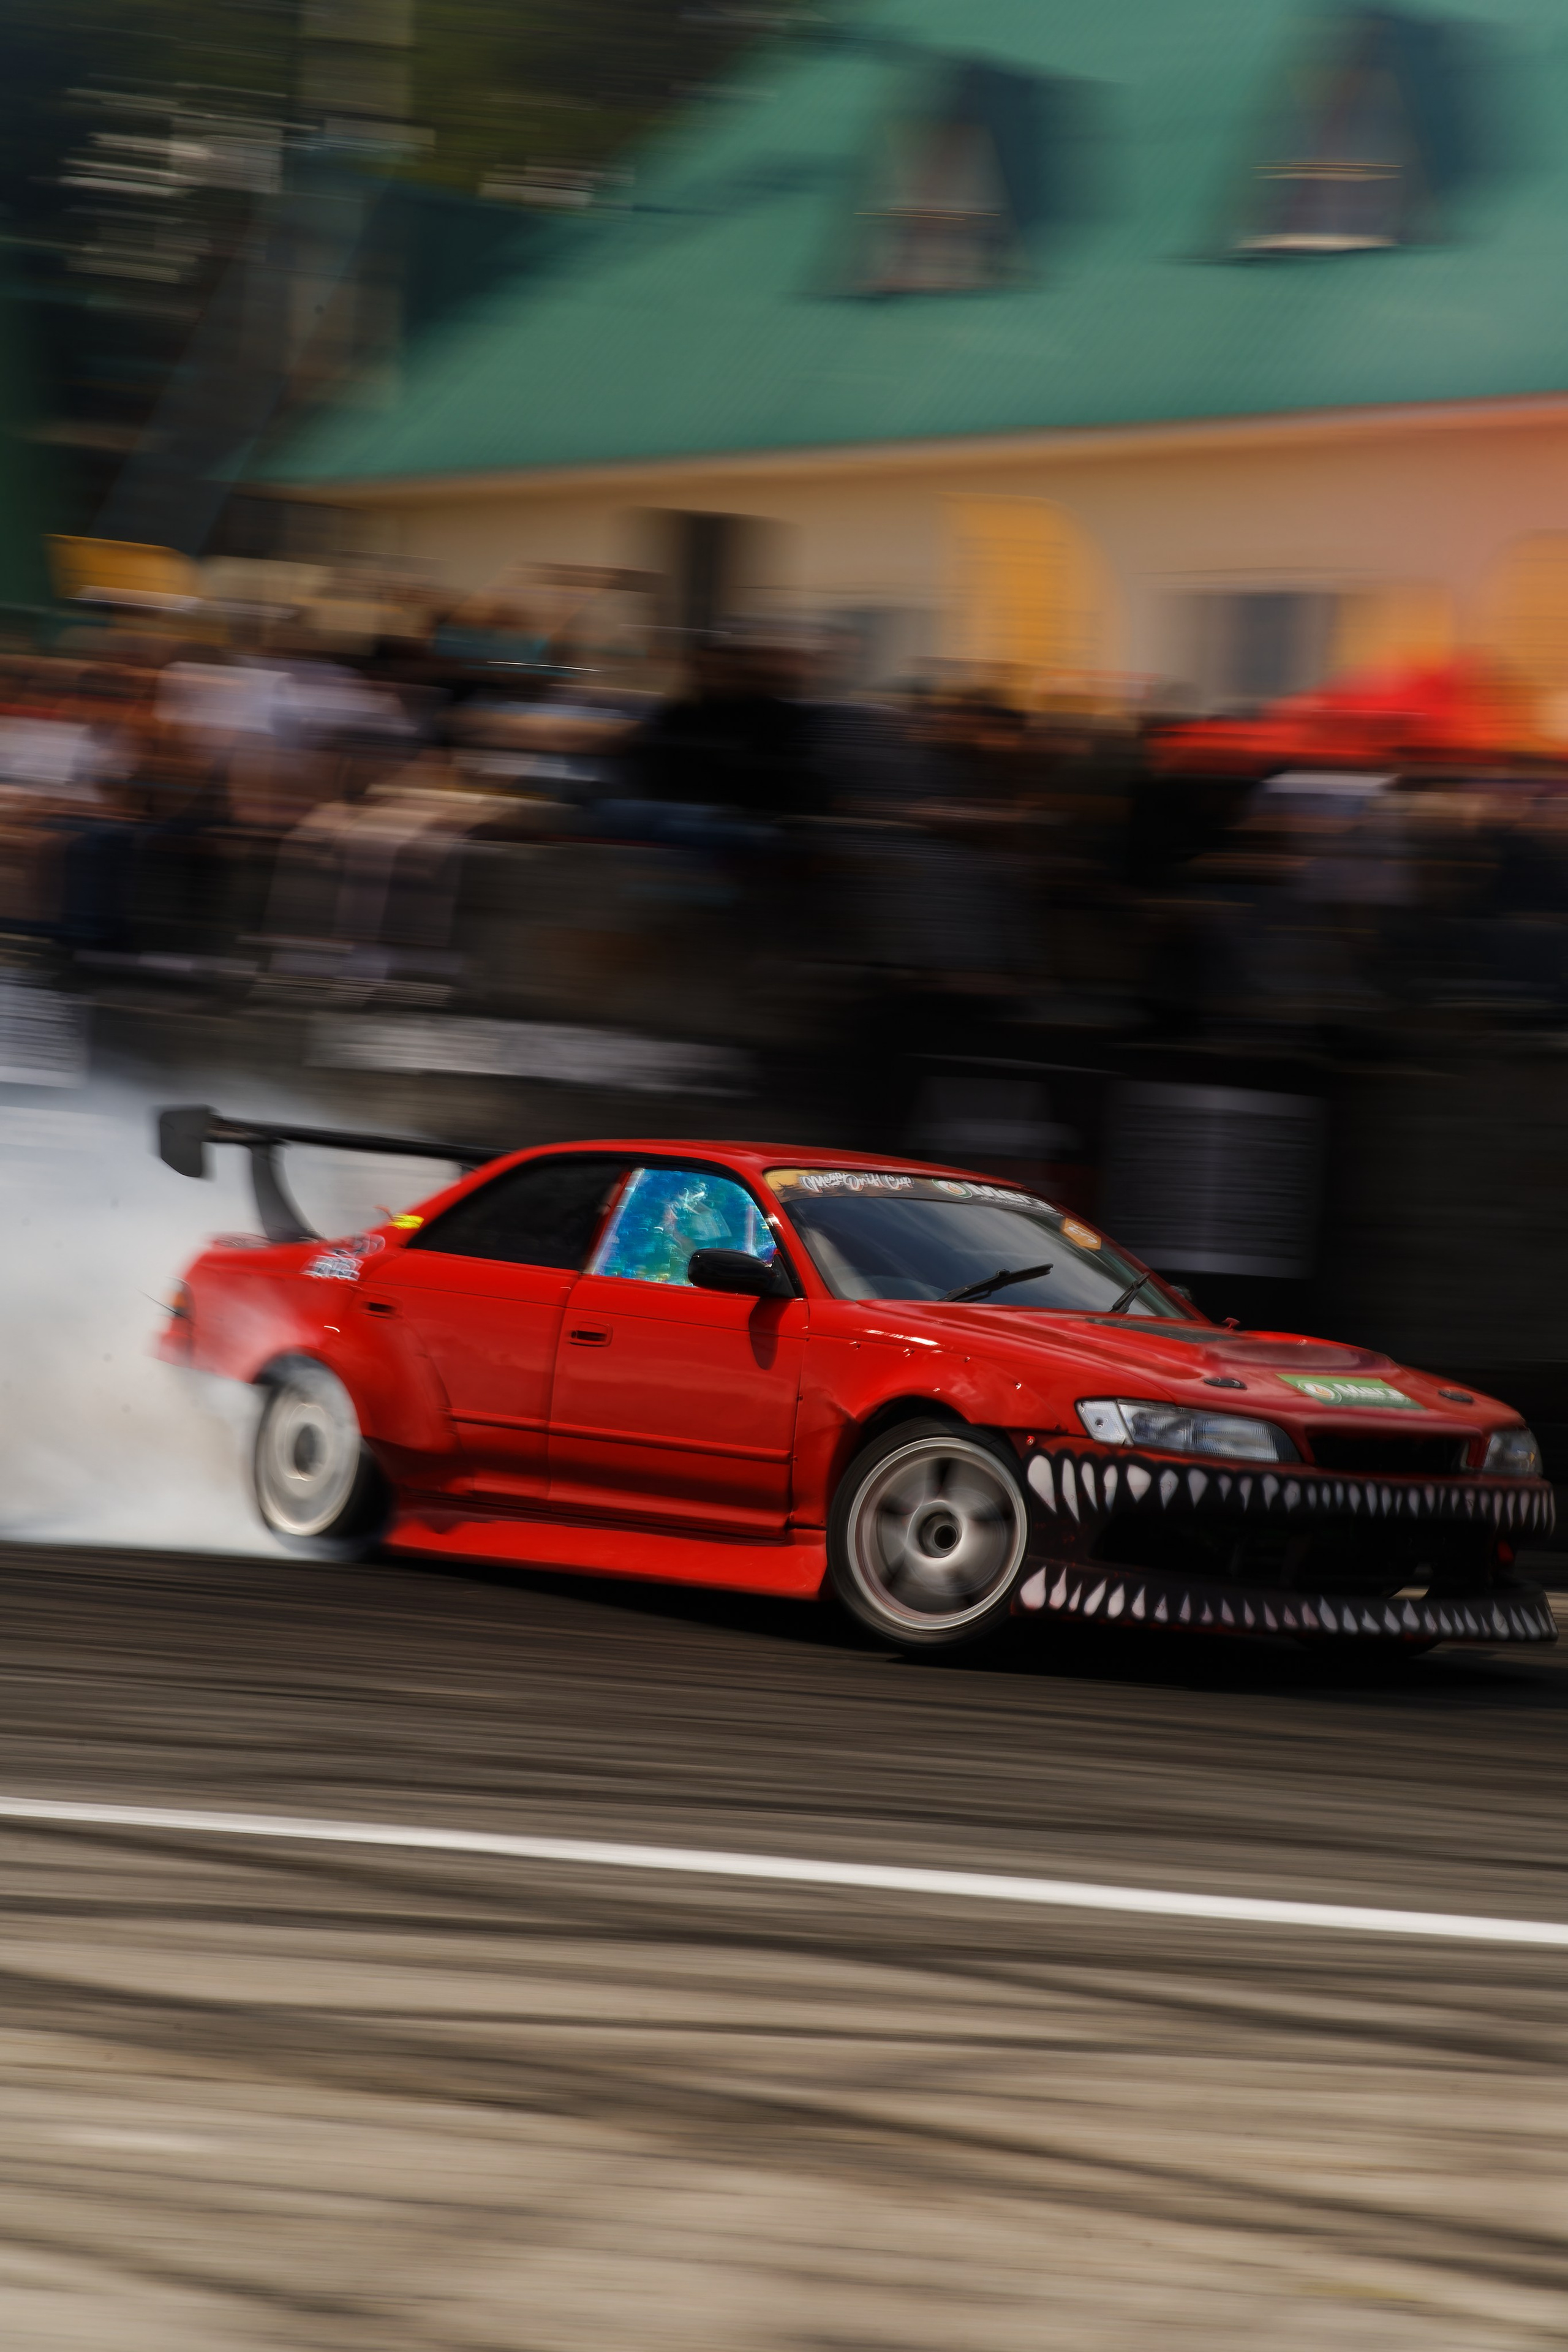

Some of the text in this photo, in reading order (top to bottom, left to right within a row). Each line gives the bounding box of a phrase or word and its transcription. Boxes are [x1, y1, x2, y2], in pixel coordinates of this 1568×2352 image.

[801, 1172, 913, 1193] Mega Drift Cup
